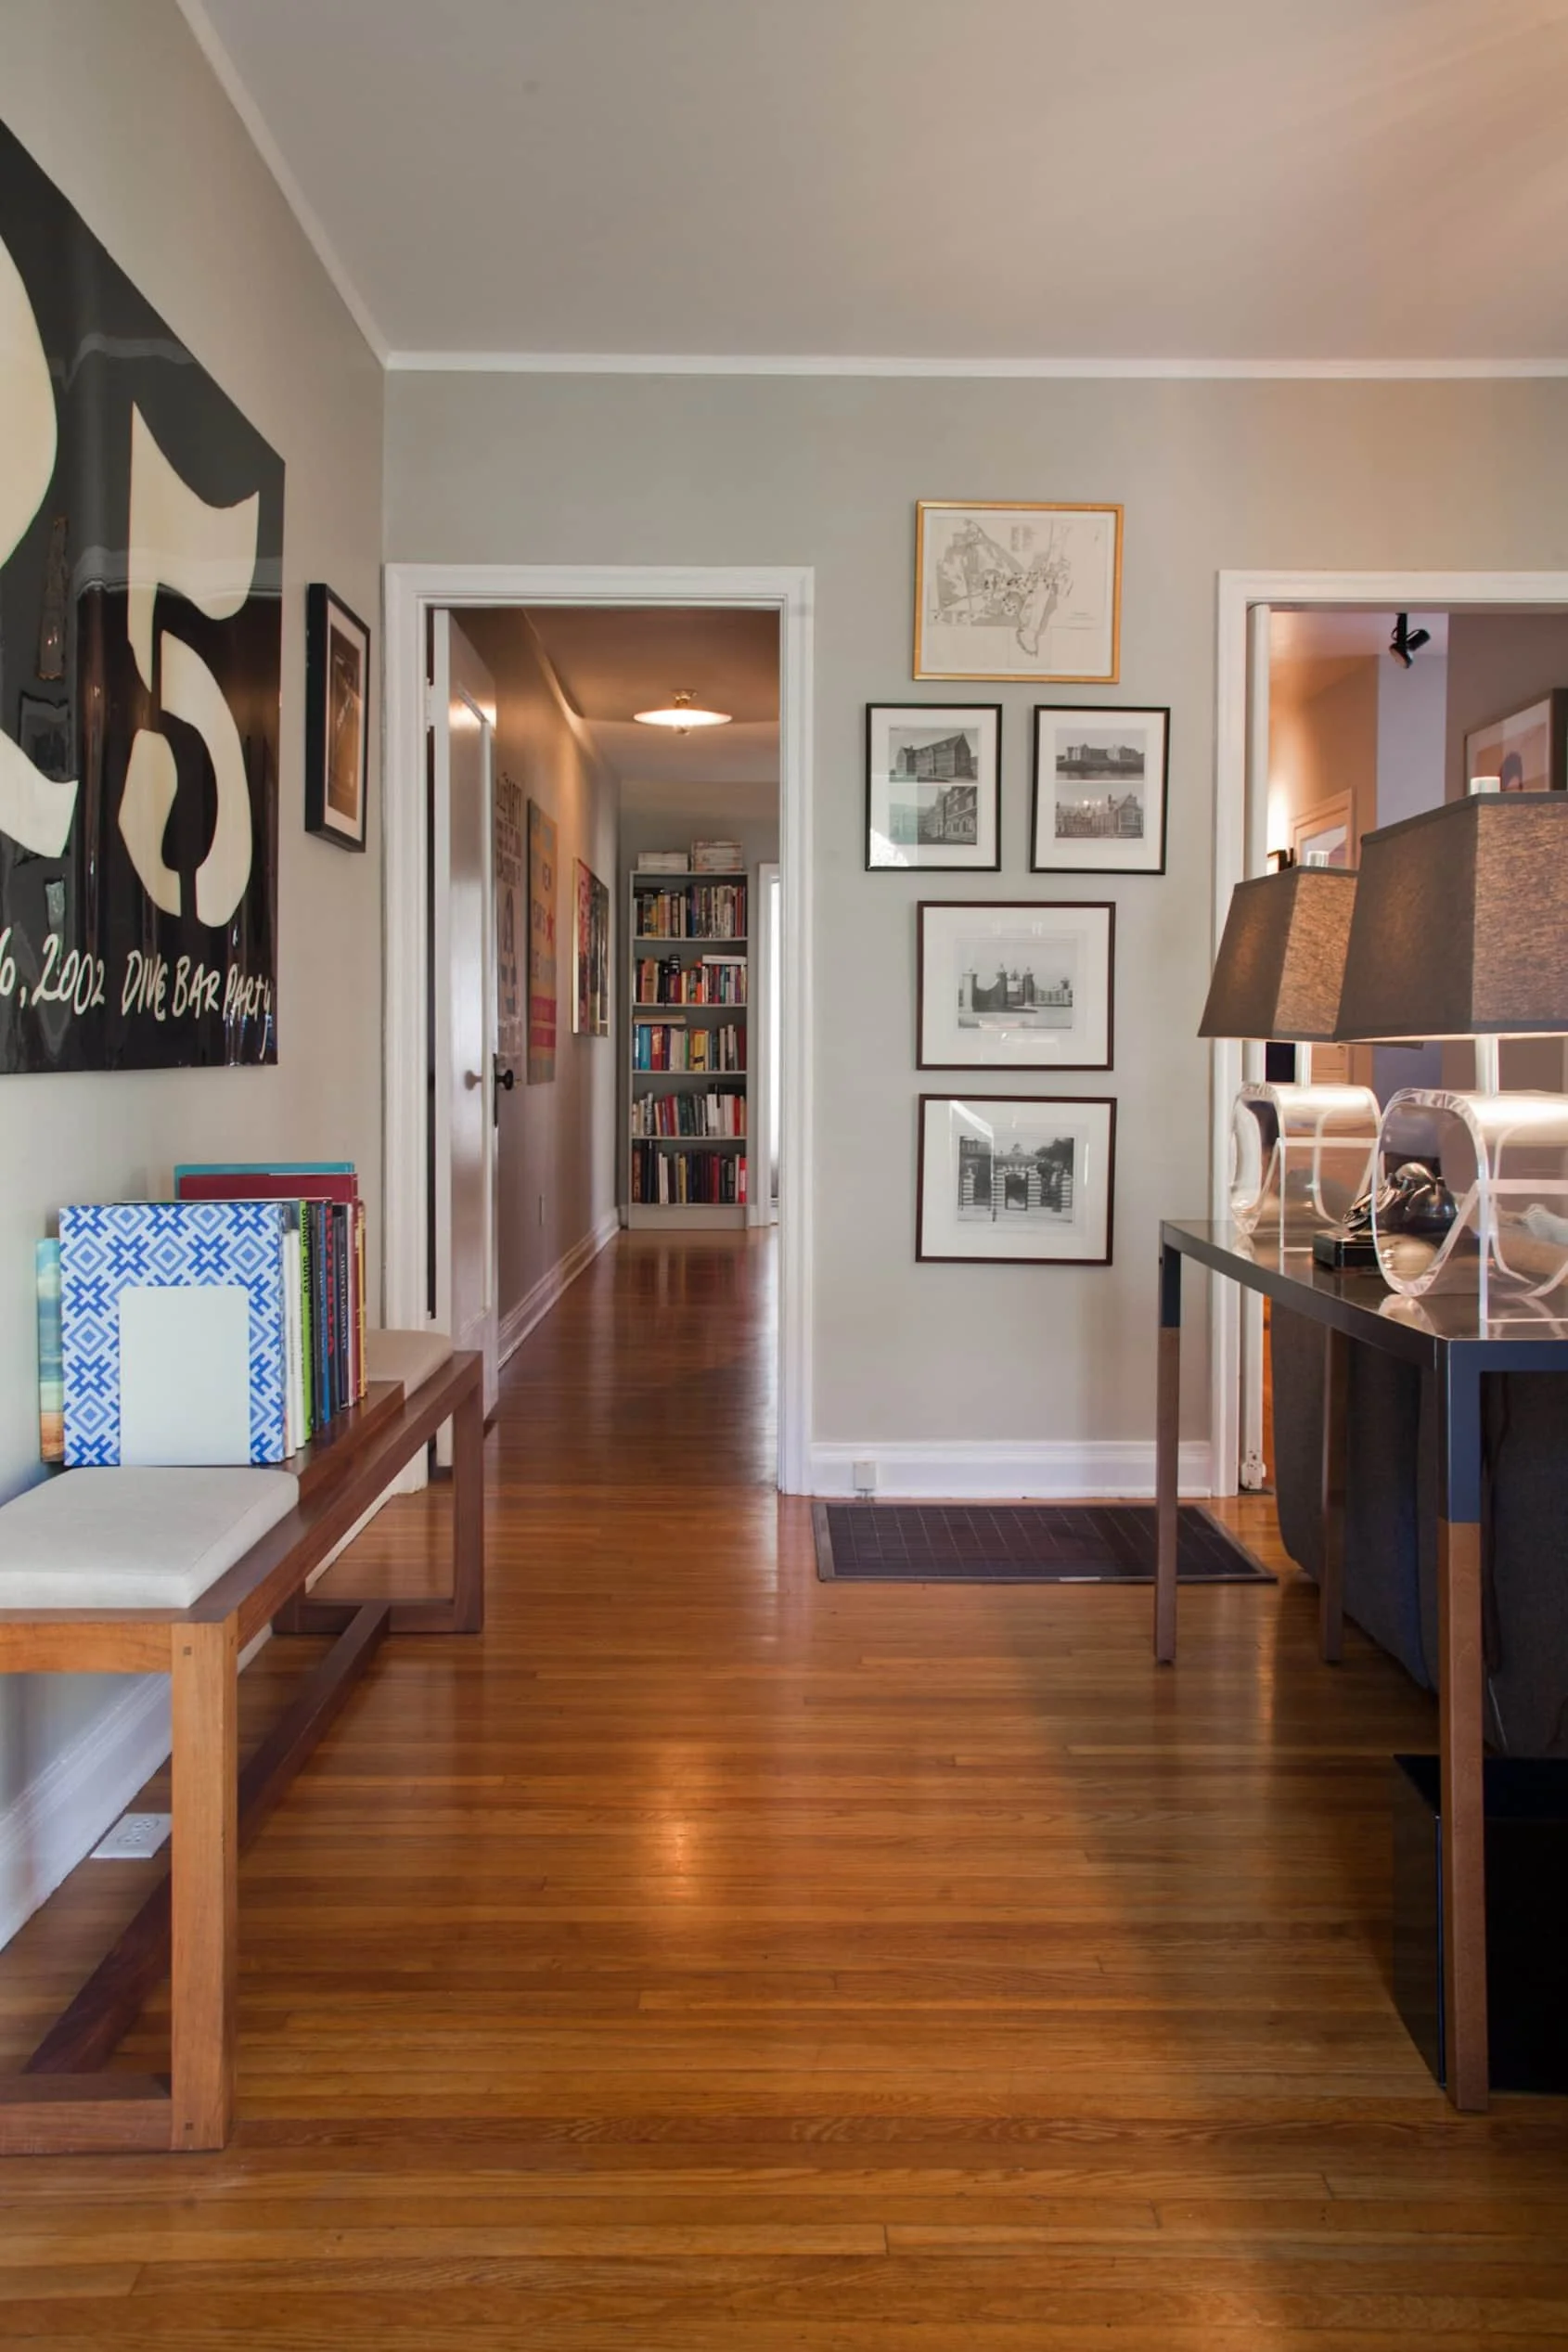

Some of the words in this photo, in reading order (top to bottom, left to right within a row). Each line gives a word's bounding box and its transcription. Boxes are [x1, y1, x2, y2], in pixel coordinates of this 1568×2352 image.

[31, 932, 105, 1016] 2002
[122, 949, 168, 1022] DIVE
[172, 955, 220, 1020] BAR
